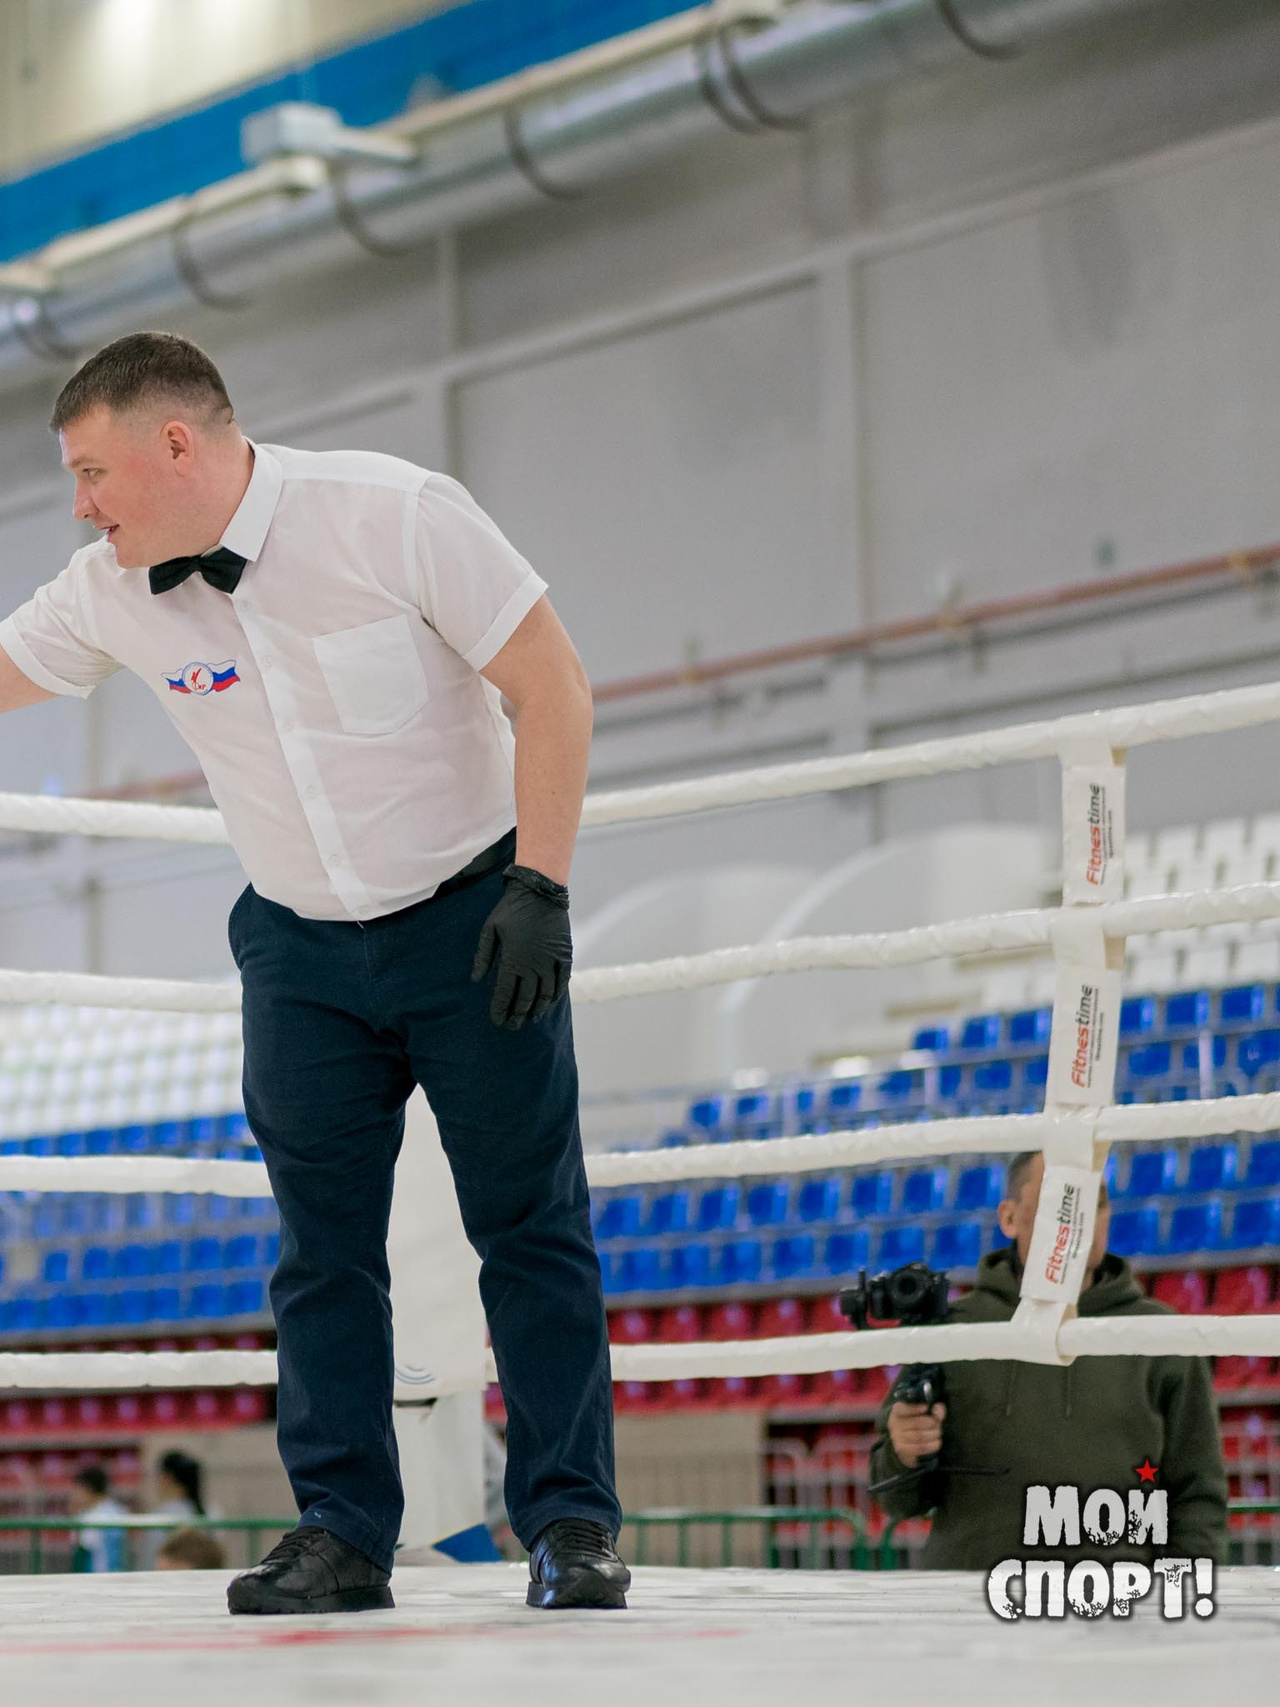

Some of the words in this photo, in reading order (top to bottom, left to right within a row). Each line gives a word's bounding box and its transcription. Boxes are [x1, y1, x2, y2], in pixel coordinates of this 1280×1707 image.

[1086, 783, 1102, 885] Fitnestime
[1071, 984, 1093, 1088] Fitnestime
[1045, 1183, 1076, 1284] Fitnestime
